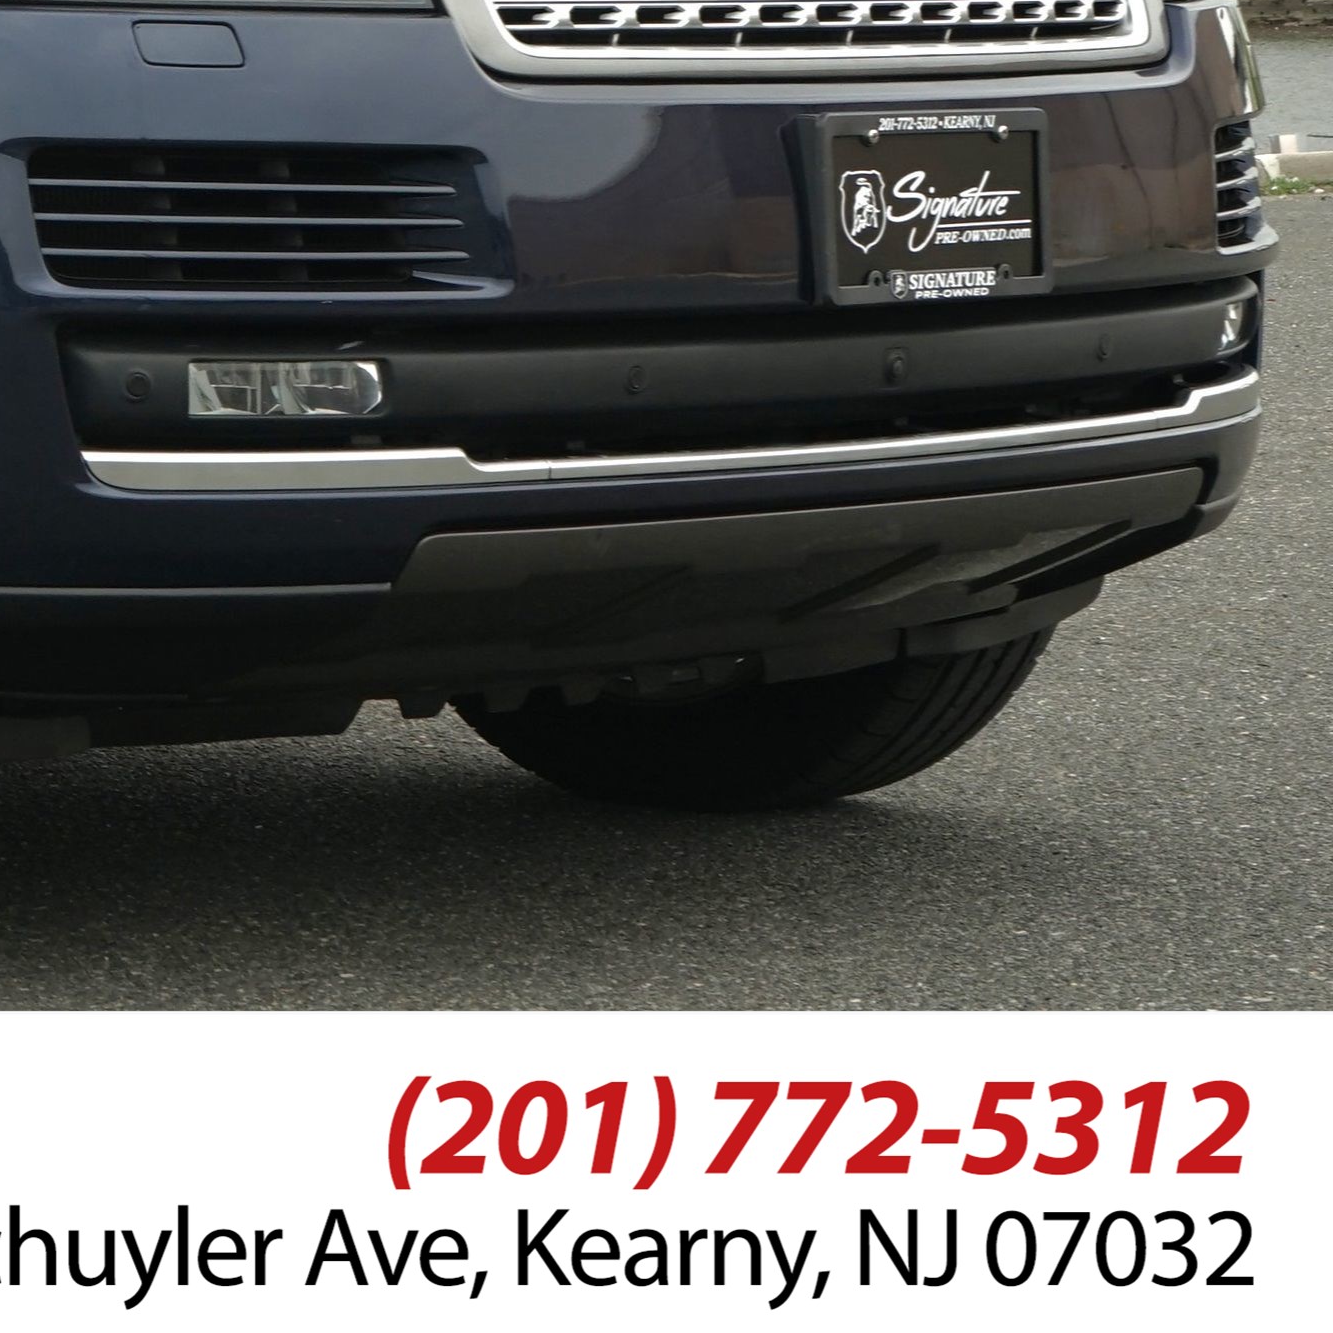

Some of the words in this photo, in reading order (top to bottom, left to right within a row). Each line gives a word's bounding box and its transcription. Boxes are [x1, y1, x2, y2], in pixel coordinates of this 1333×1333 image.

[878, 116, 938, 131] 201-772-5312
[983, 114, 996, 128] NJ
[886, 170, 1021, 252] Signature
[935, 223, 1032, 244] PRE-OWNED.com
[909, 270, 996, 290] SIGNATURE
[914, 287, 990, 299] PRE-OWNED
